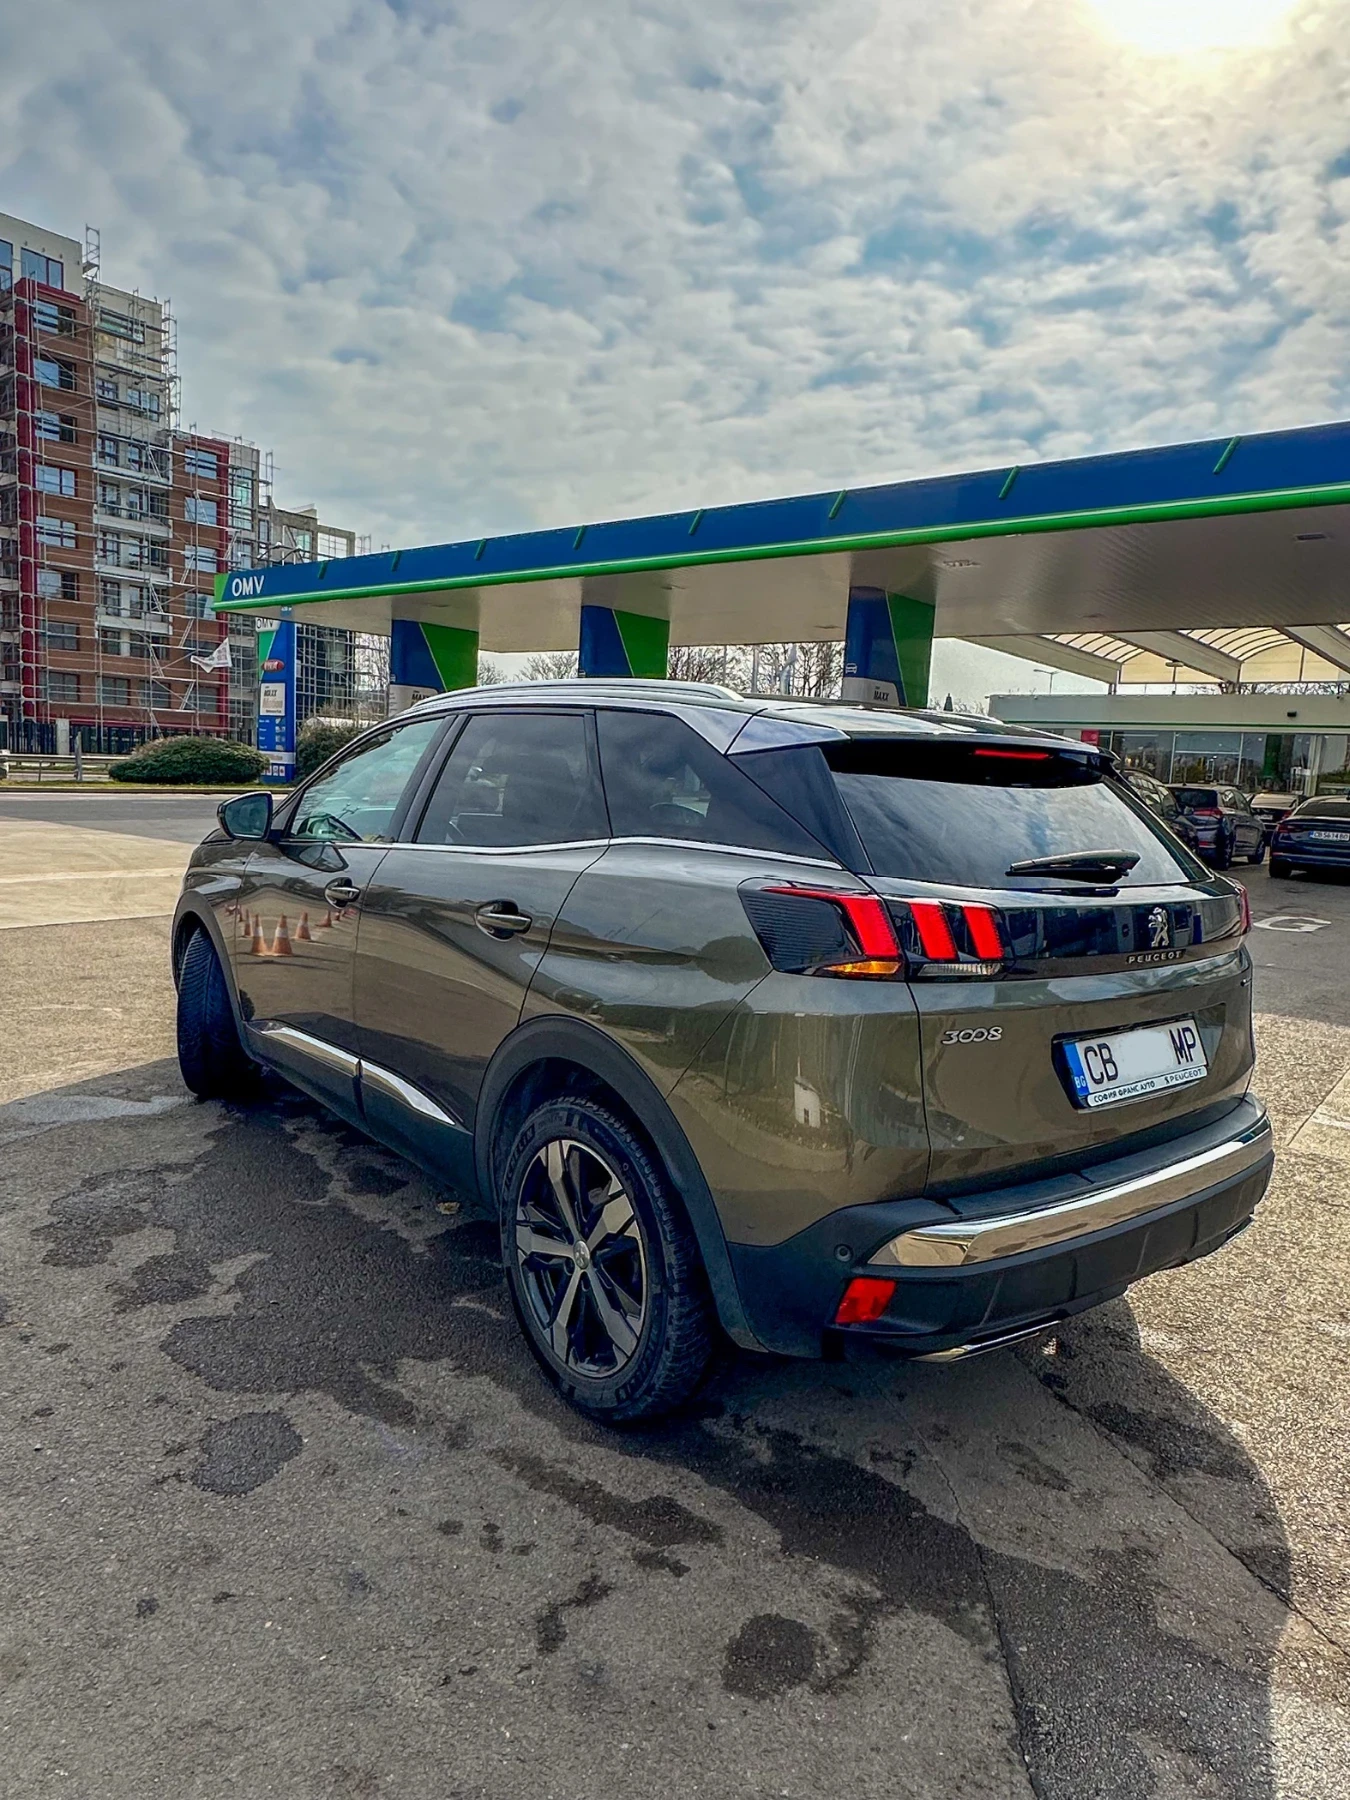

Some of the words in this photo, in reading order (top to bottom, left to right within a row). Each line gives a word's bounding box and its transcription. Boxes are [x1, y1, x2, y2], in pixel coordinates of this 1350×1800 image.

[232, 575, 264, 596] OMV
[256, 618, 274, 629] OMV
[1128, 950, 1181, 964] PEUGEOT
[942, 1026, 1003, 1045] 3008
[1084, 1042, 1119, 1085] CB
[1169, 1026, 1196, 1065] MP
[1074, 1075, 1087, 1089] BG
[1169, 1068, 1202, 1083] PEUGEOT
[1093, 1091, 1117, 1103] СОФИЯ
[1118, 1084, 1140, 1097] ФРАНС
[1140, 1079, 1156, 1091] АУТО
